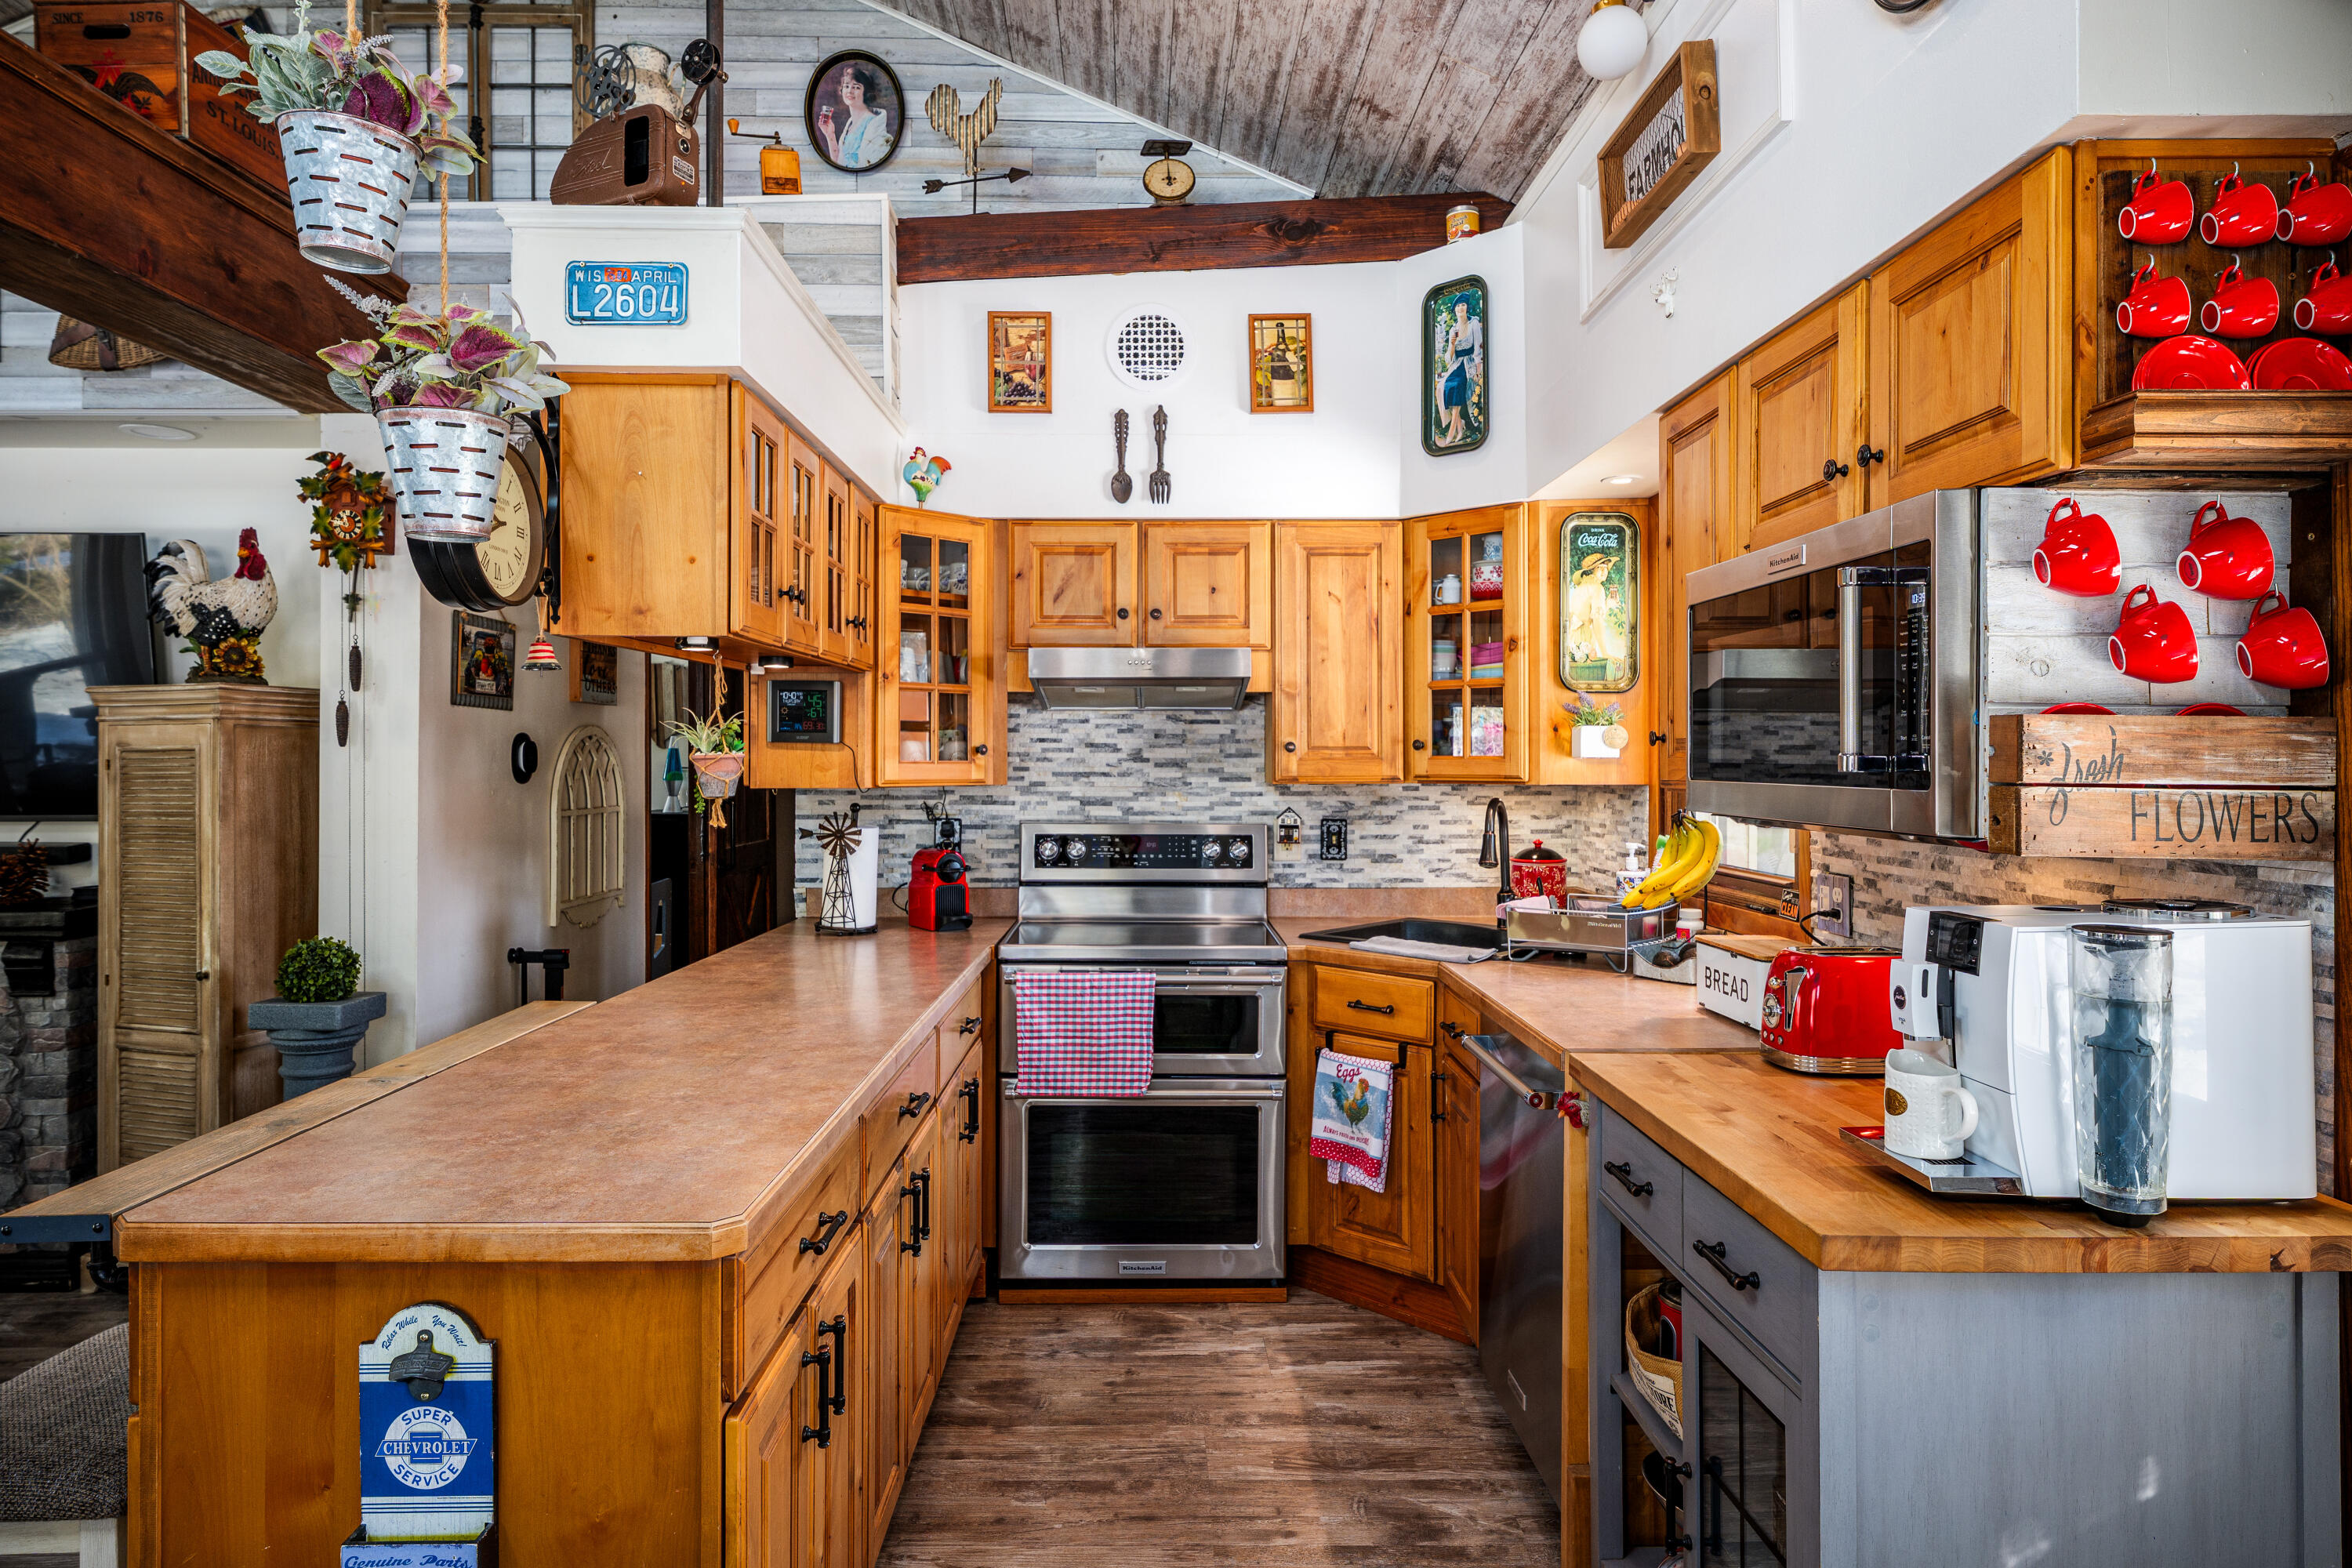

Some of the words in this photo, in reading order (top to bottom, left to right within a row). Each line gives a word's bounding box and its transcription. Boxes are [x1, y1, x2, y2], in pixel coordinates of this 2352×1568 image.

[53, 12, 84, 24] SINCE
[129, 11, 164, 23] 1876
[206, 100, 230, 127] ST.
[232, 117, 279, 160] LOUIS.
[575, 270, 601, 282] WIS
[630, 270, 677, 283] APRIL
[572, 284, 679, 318] L2604
[516, 525, 525, 540] III
[1577, 532, 1618, 547] Coca-Cola
[1769, 552, 1799, 568] KitchenAid
[2129, 789, 2320, 844] FLOWERS
[1780, 902, 1798, 920] CLEAN
[1705, 966, 1748, 1003] BREAD
[1336, 1063, 1363, 1083] Eggs
[1323, 1125, 1339, 1136] ALWAYS
[382, 1330, 397, 1351] Relax
[396, 1315, 419, 1330] While
[432, 1315, 447, 1327] You
[447, 1324, 468, 1348] Wait!
[396, 1359, 446, 1370] CHEVROLET
[401, 1409, 452, 1426] SUPER
[383, 1440, 470, 1455] CHEVROLET
[394, 1463, 459, 1487] SERVICE
[344, 1555, 414, 1568] Genuine
[419, 1555, 473, 1568] Parts
